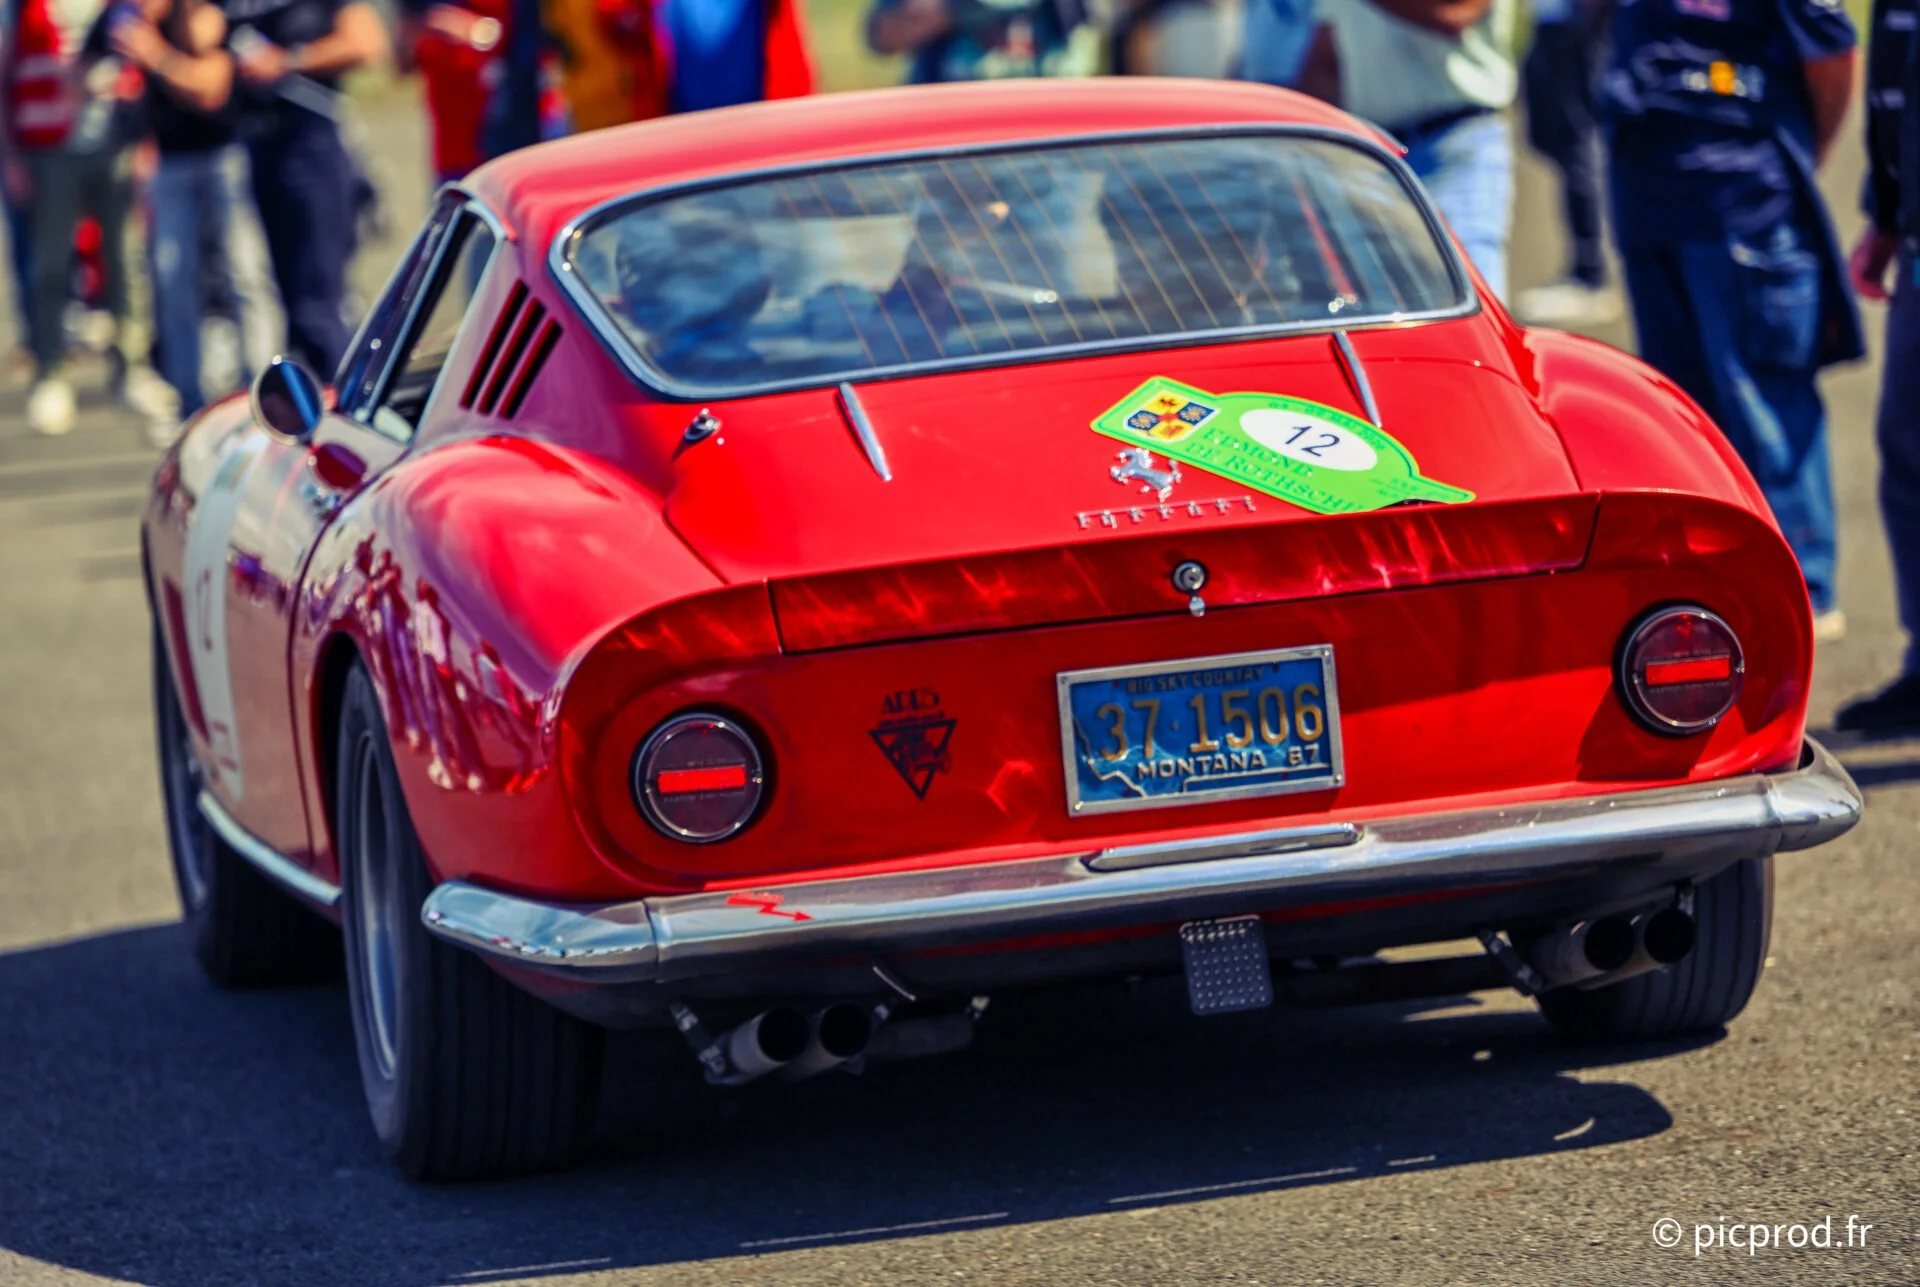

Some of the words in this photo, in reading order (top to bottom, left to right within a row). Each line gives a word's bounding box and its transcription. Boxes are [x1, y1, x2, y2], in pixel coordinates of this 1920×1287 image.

[1284, 425, 1341, 457] 12
[1126, 678, 1154, 695] BIG
[1157, 673, 1188, 693] SKY
[1192, 667, 1265, 688] COUNTRY
[1097, 698, 1161, 761] 37
[1188, 682, 1324, 754] 1506
[1137, 749, 1267, 781] MONTANA
